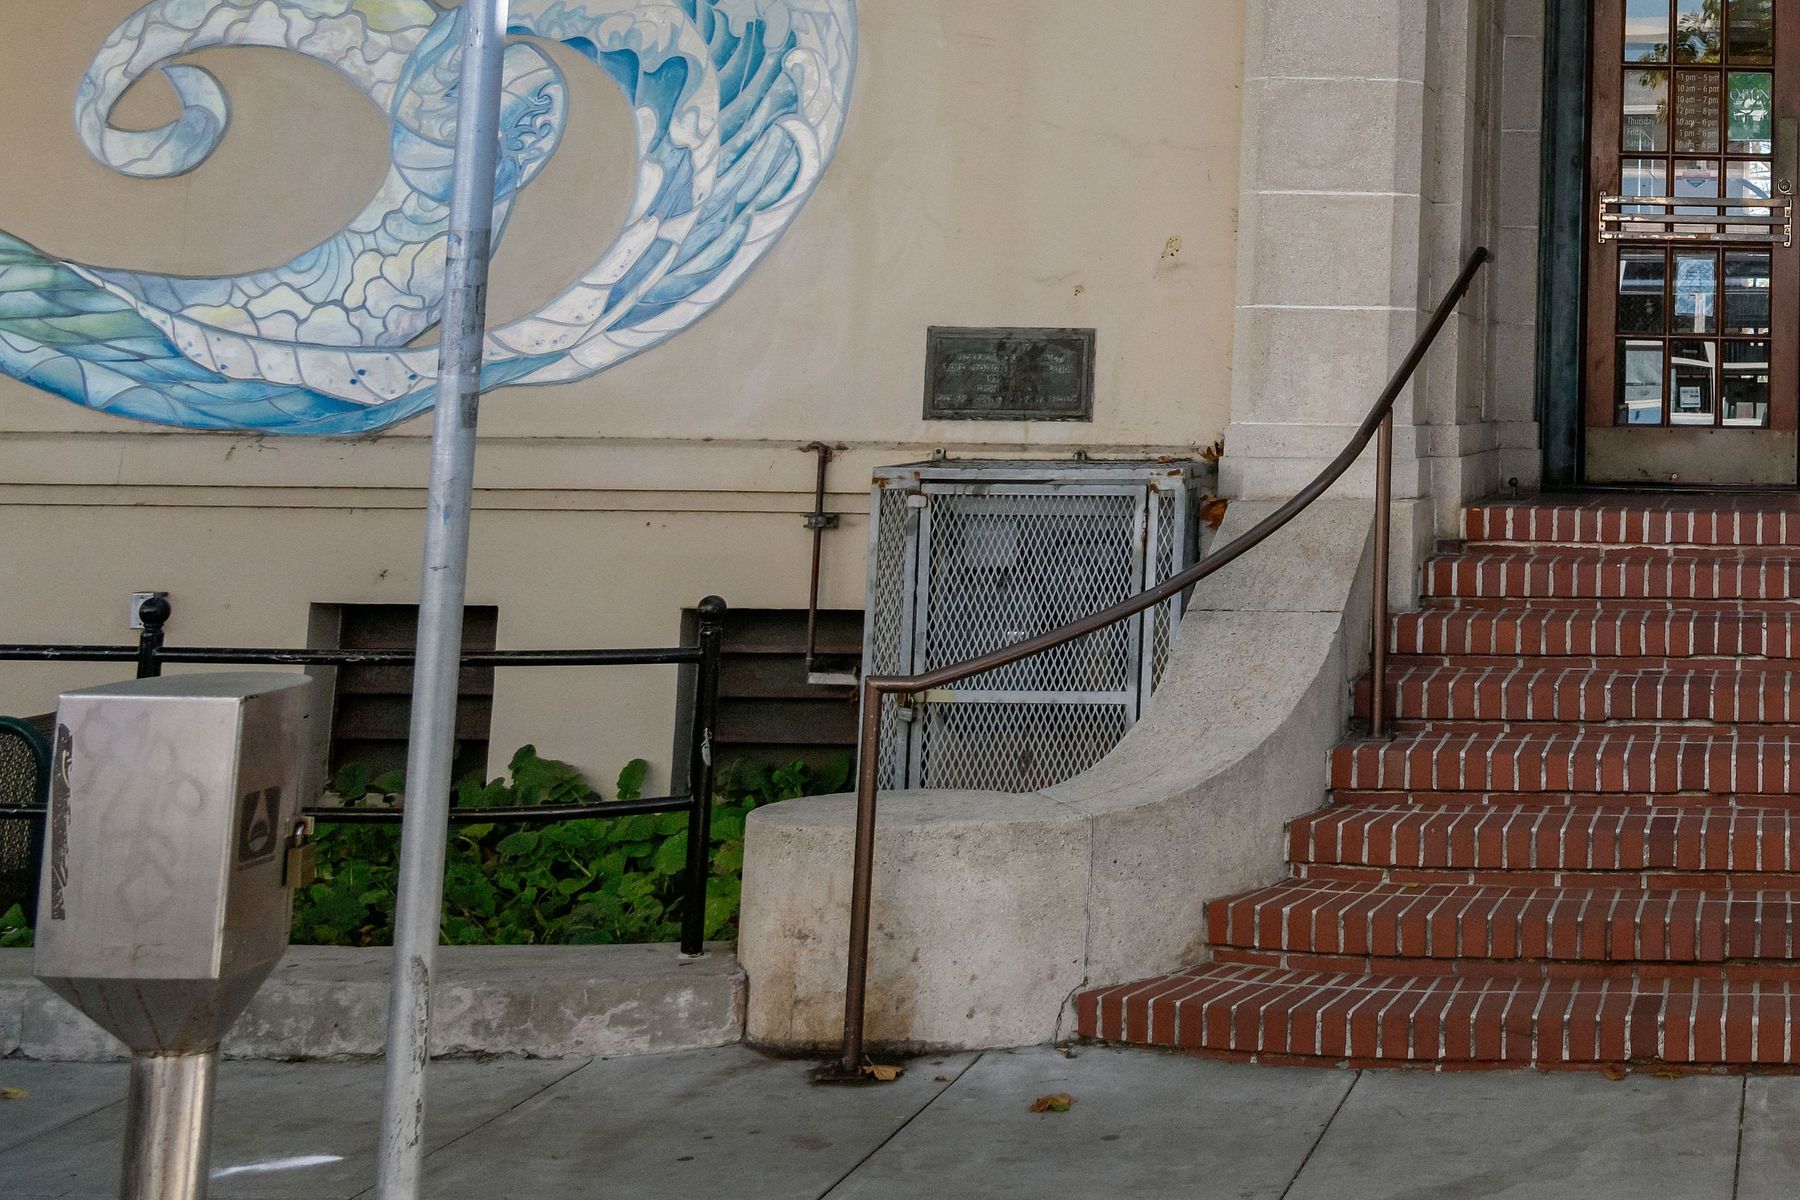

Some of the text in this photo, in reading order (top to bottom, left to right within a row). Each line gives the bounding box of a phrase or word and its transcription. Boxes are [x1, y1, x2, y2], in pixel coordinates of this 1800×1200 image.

[1704, 73, 1708, 81] 5
[1626, 116, 1654, 126] Thursday
[1626, 128, 1646, 138] Friday
